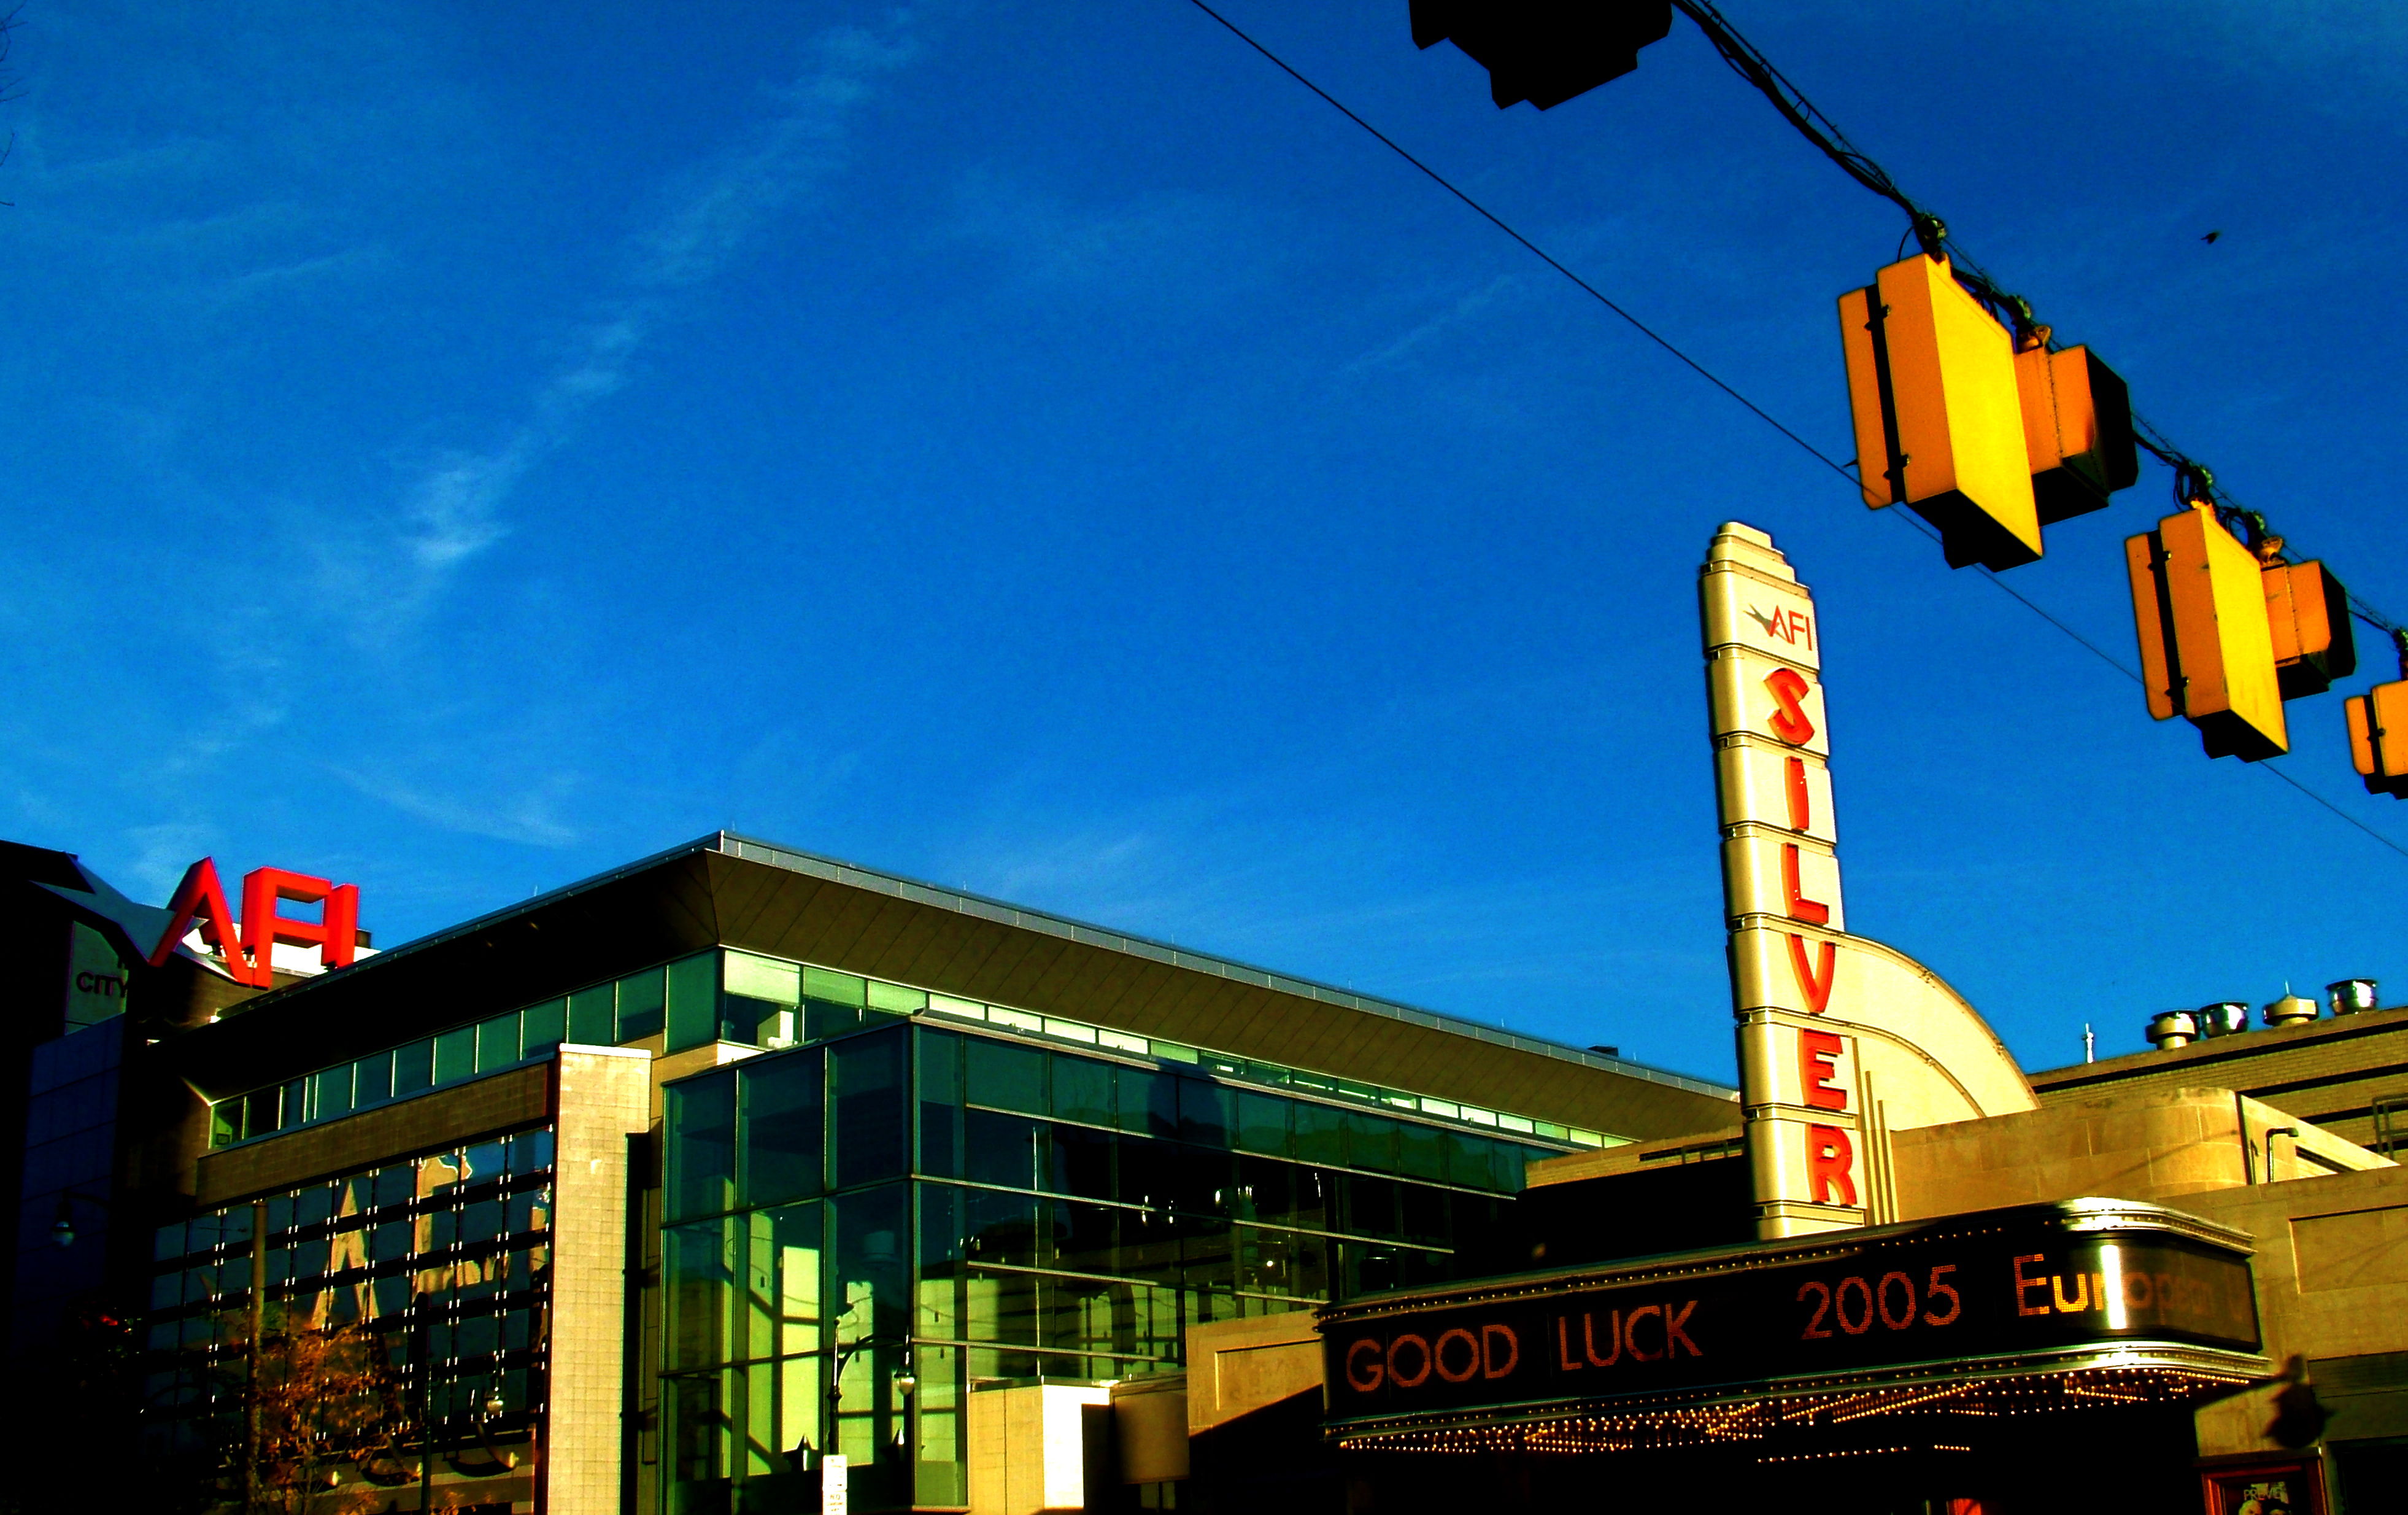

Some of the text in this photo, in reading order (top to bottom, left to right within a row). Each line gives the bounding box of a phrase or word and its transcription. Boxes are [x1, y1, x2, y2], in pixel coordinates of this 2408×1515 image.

[1769, 605, 1812, 651] AFI
[77, 971, 127, 998] CITY
[149, 855, 359, 990] AFI
[1764, 667, 1858, 1206] SILVER
[1346, 1323, 1519, 1393] GOOD
[1559, 1300, 1703, 1371] LUCK
[1796, 1264, 1961, 1340] 2005
